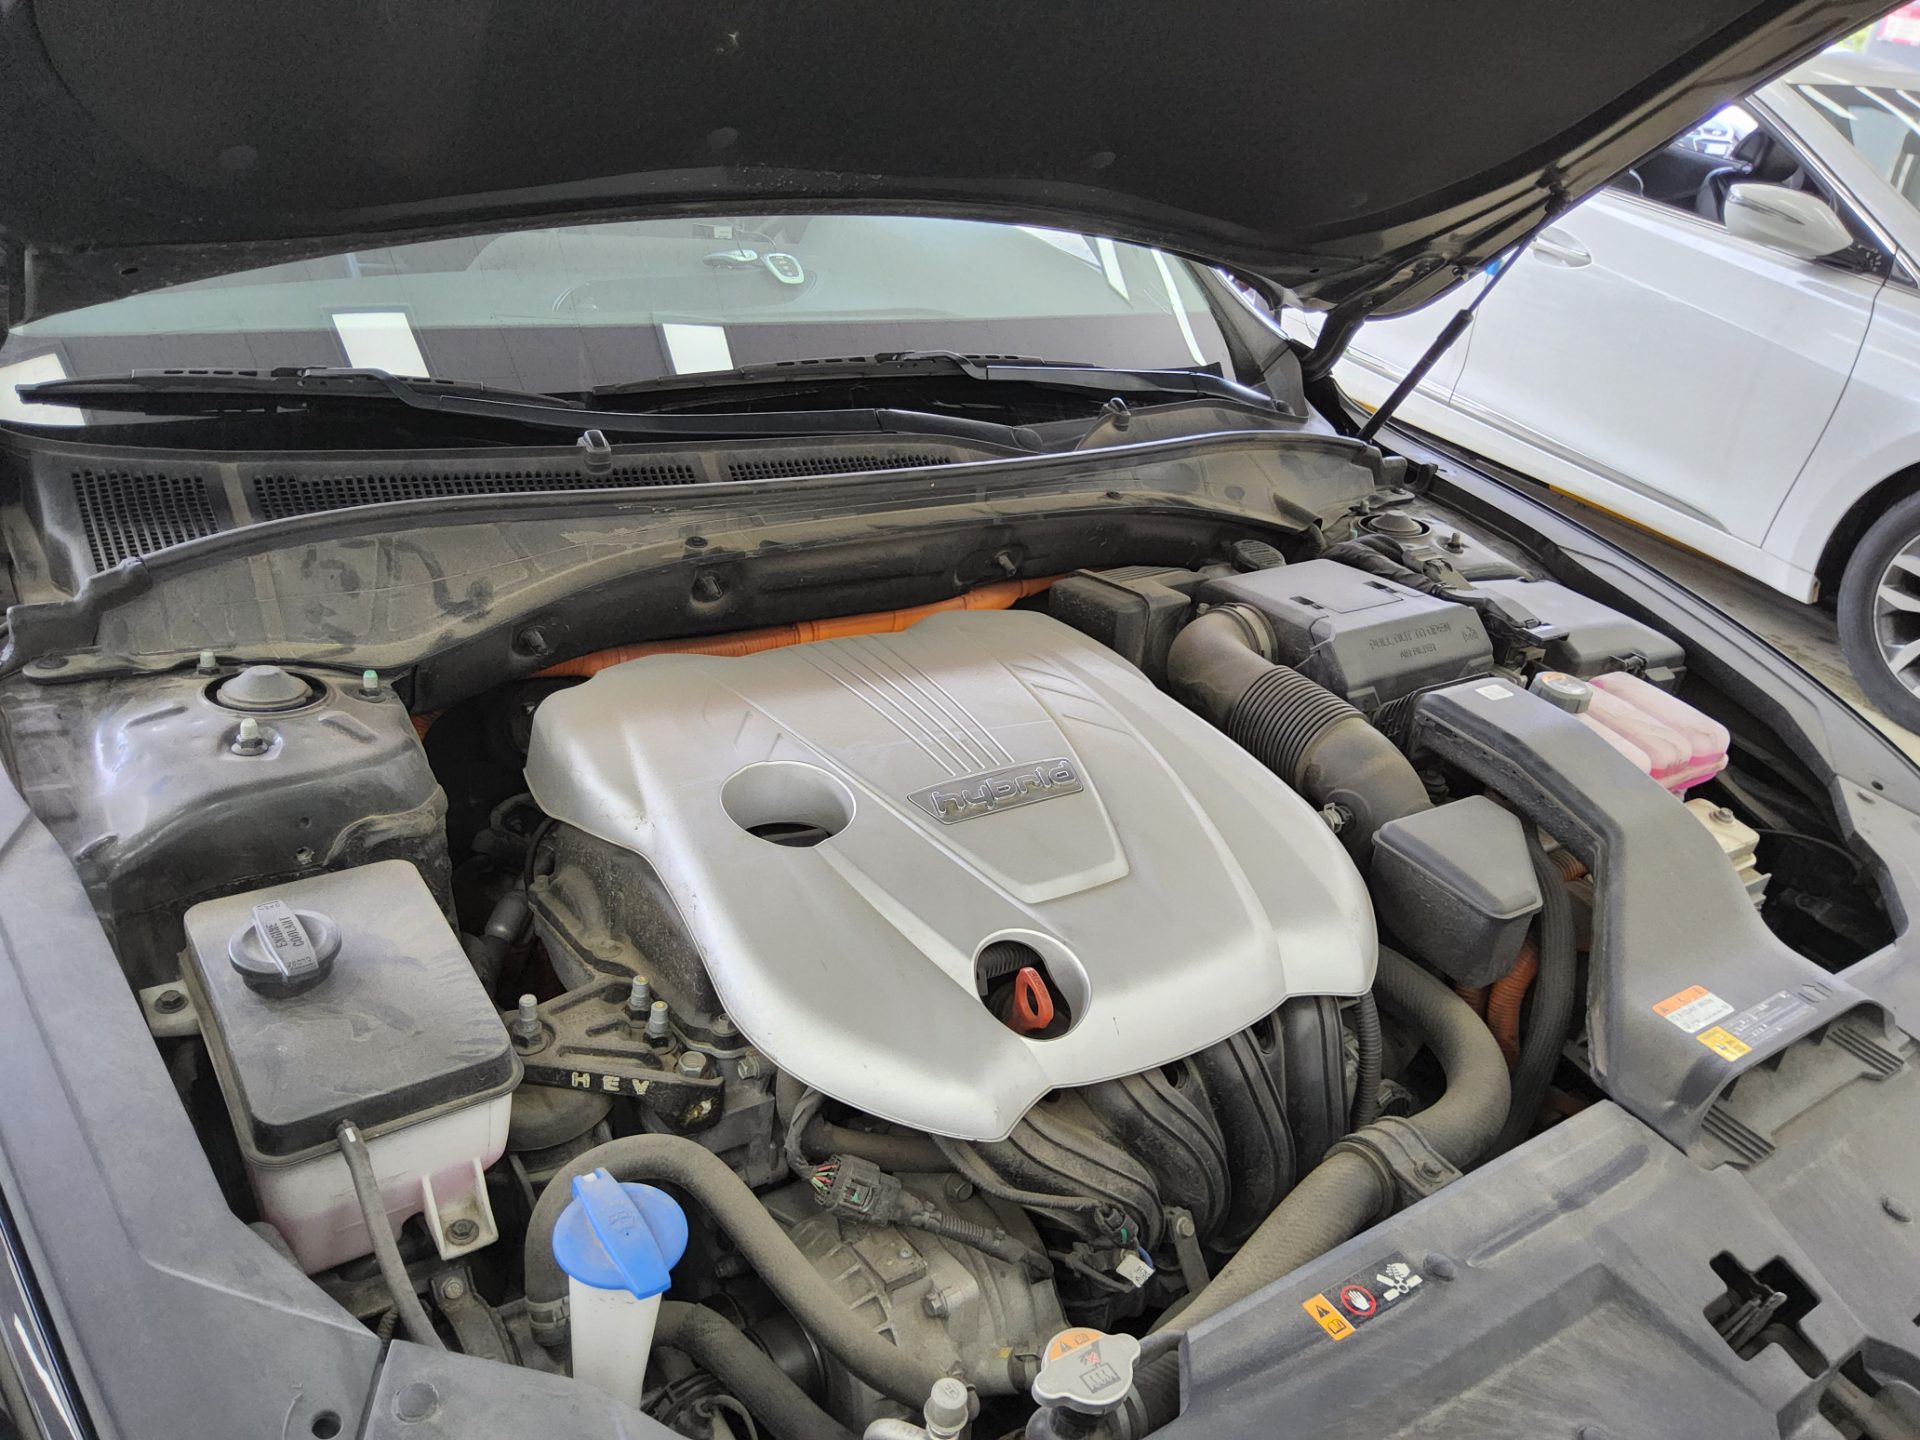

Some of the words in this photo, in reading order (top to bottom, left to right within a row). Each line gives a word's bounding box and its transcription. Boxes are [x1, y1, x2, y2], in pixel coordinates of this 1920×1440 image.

[931, 760, 1077, 817] hybrid
[265, 923, 288, 948] ENGINE
[279, 916, 305, 948] COOLANT
